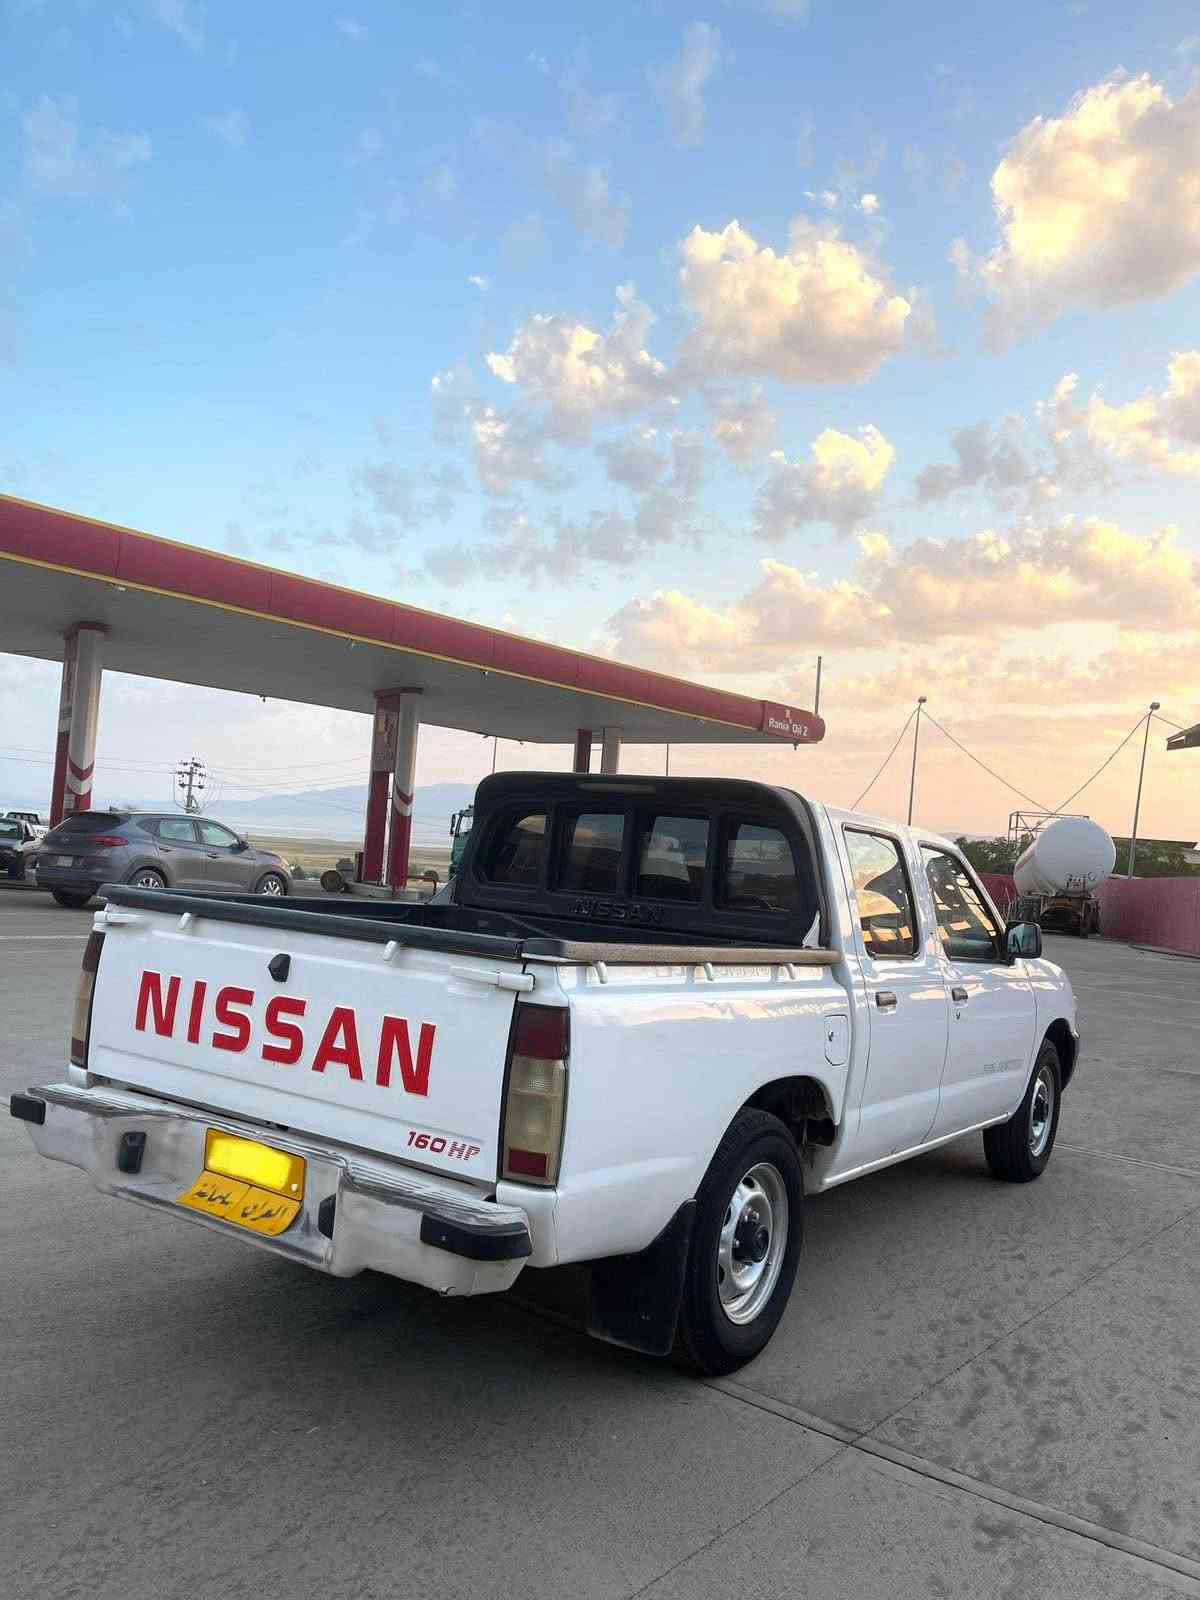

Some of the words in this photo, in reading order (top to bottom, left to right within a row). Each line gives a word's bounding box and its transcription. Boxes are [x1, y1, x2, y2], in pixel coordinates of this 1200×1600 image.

[803, 725, 809, 737] 2
[568, 896, 667, 924] NISSAN
[135, 970, 437, 1097] NISSAN
[407, 1131, 447, 1153] 160
[447, 1141, 481, 1161] HP
